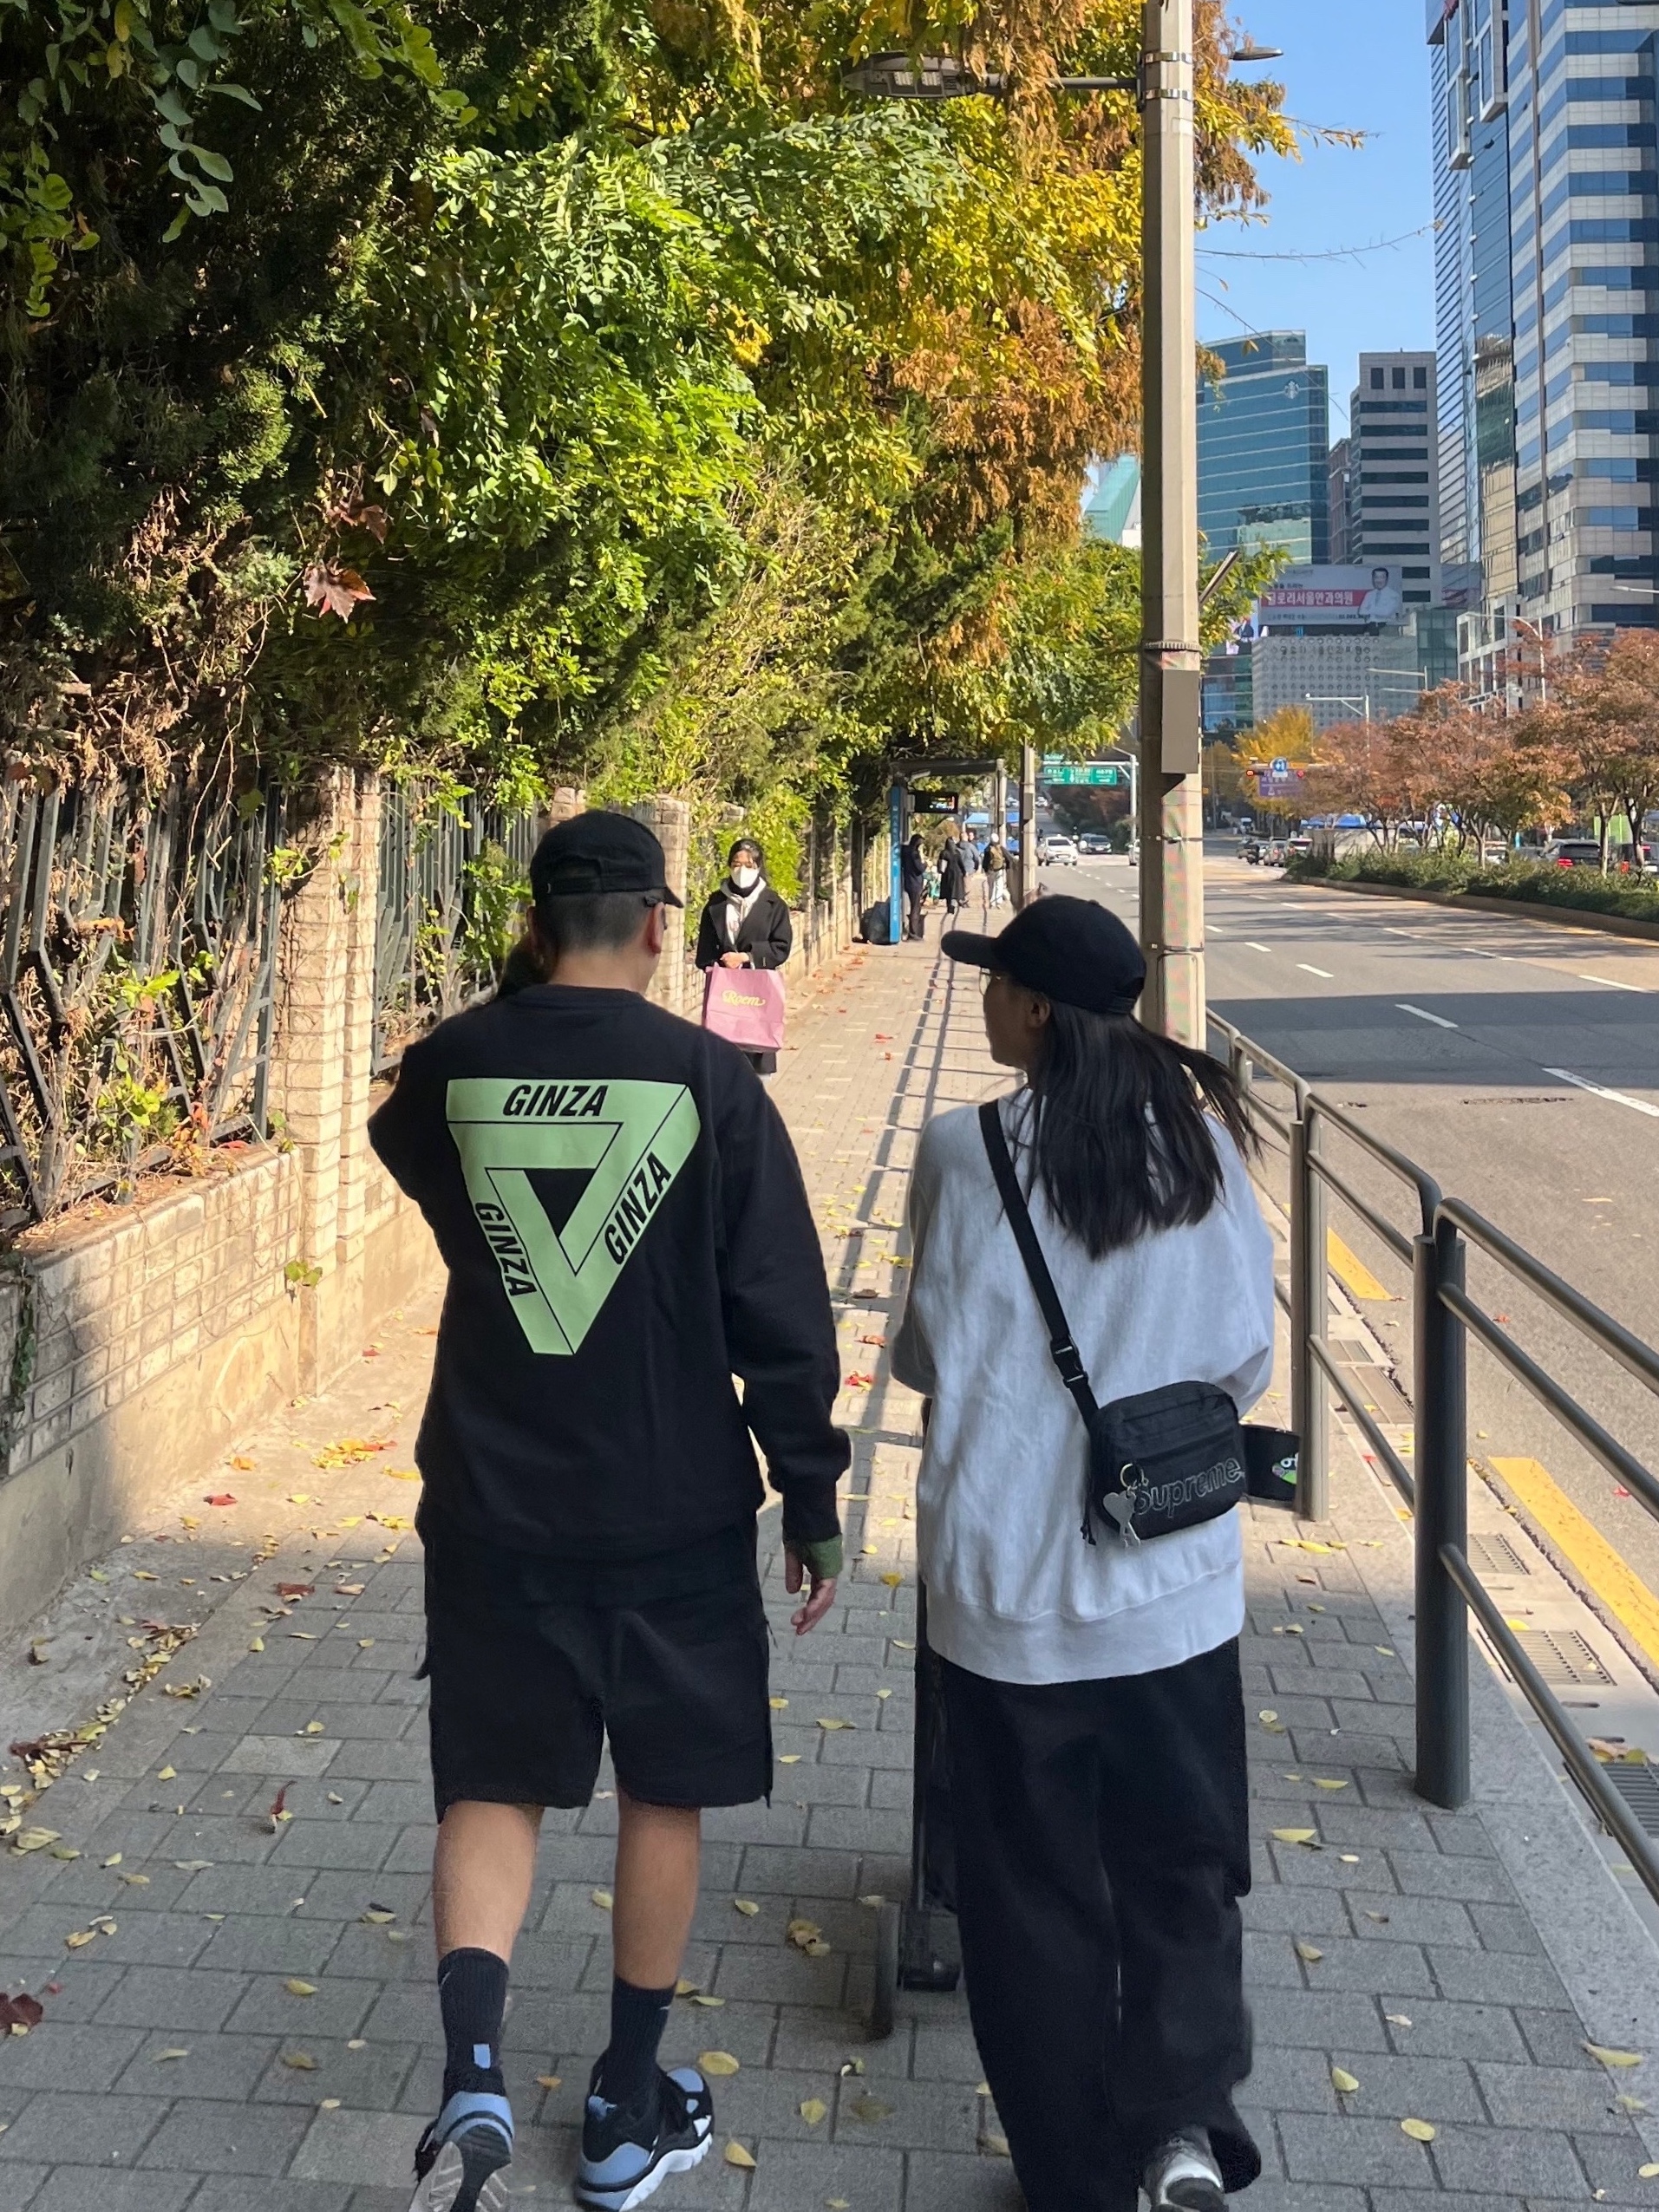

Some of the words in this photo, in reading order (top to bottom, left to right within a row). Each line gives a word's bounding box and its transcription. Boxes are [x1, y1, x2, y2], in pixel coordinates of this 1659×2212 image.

[502, 1084, 609, 1117] GINZA
[474, 1202, 537, 1297] GINZA
[604, 1151, 671, 1265] GINZA
